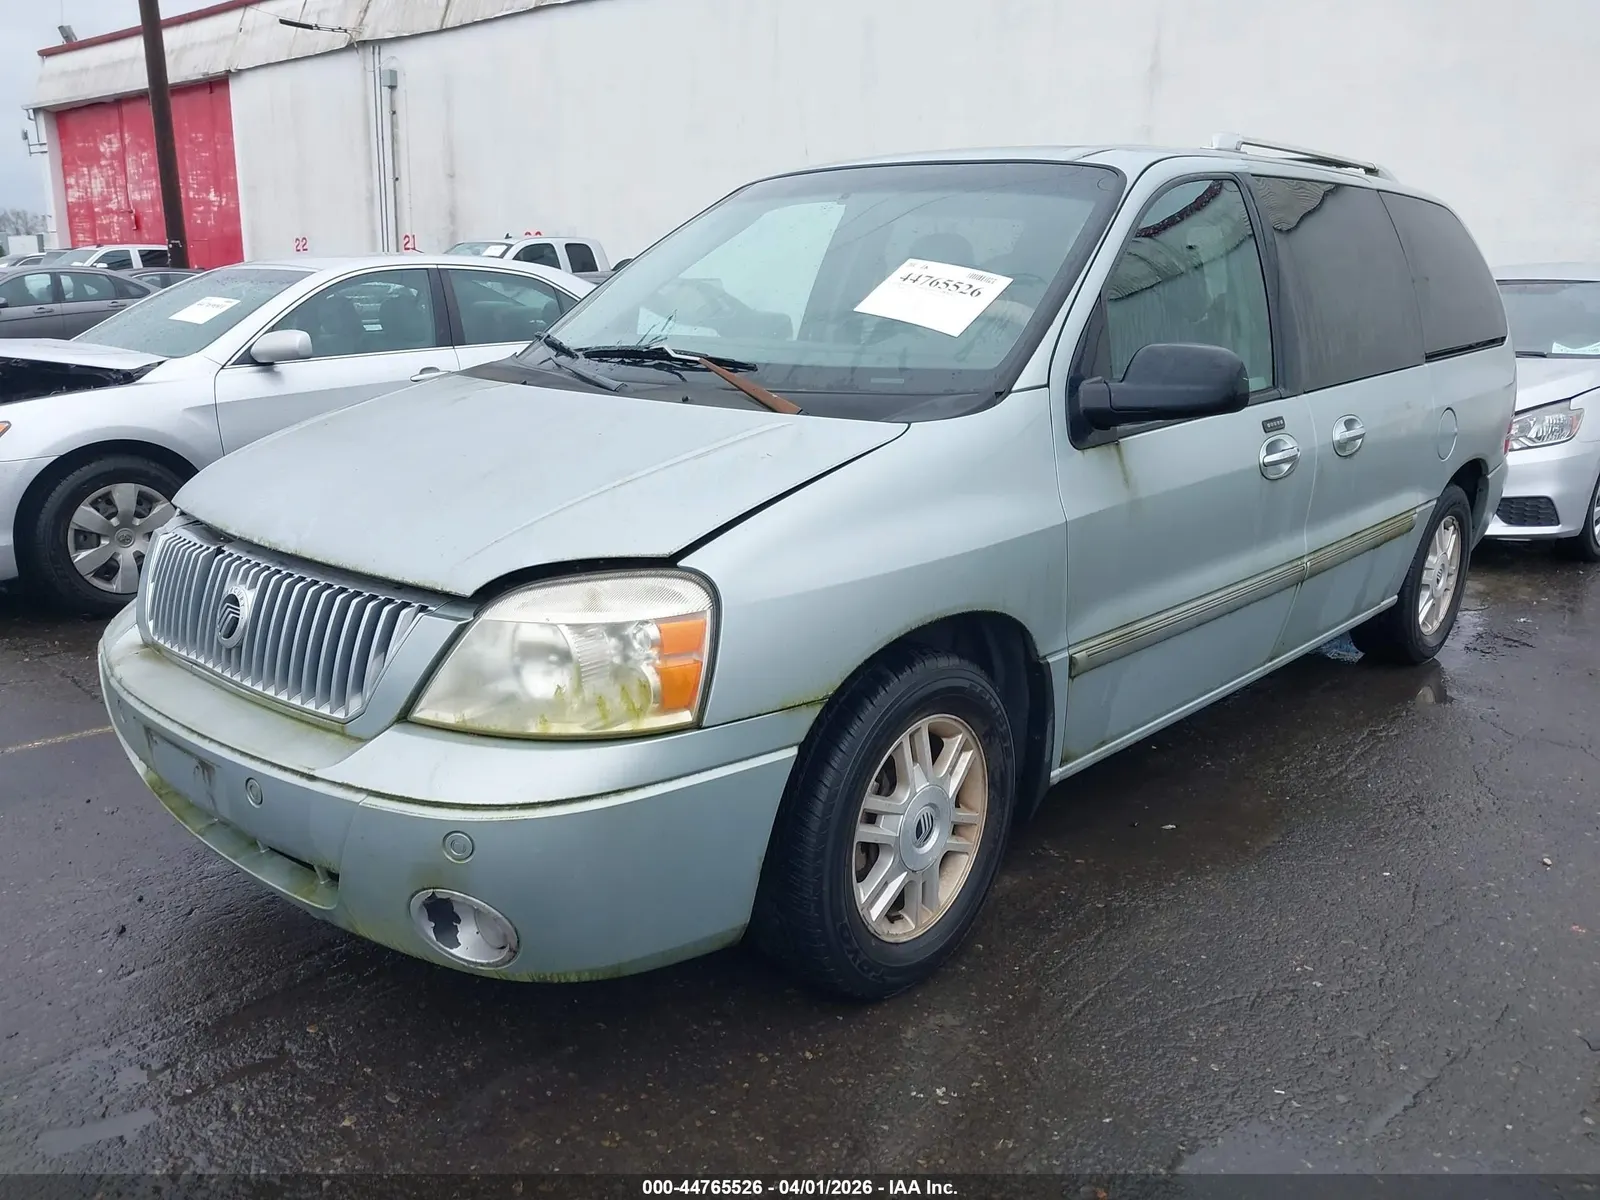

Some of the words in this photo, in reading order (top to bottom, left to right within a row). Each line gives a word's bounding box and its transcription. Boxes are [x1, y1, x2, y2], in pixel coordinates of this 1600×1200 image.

[294, 237, 308, 252] 22
[403, 234, 416, 251] 21
[899, 271, 983, 298] 44765526
